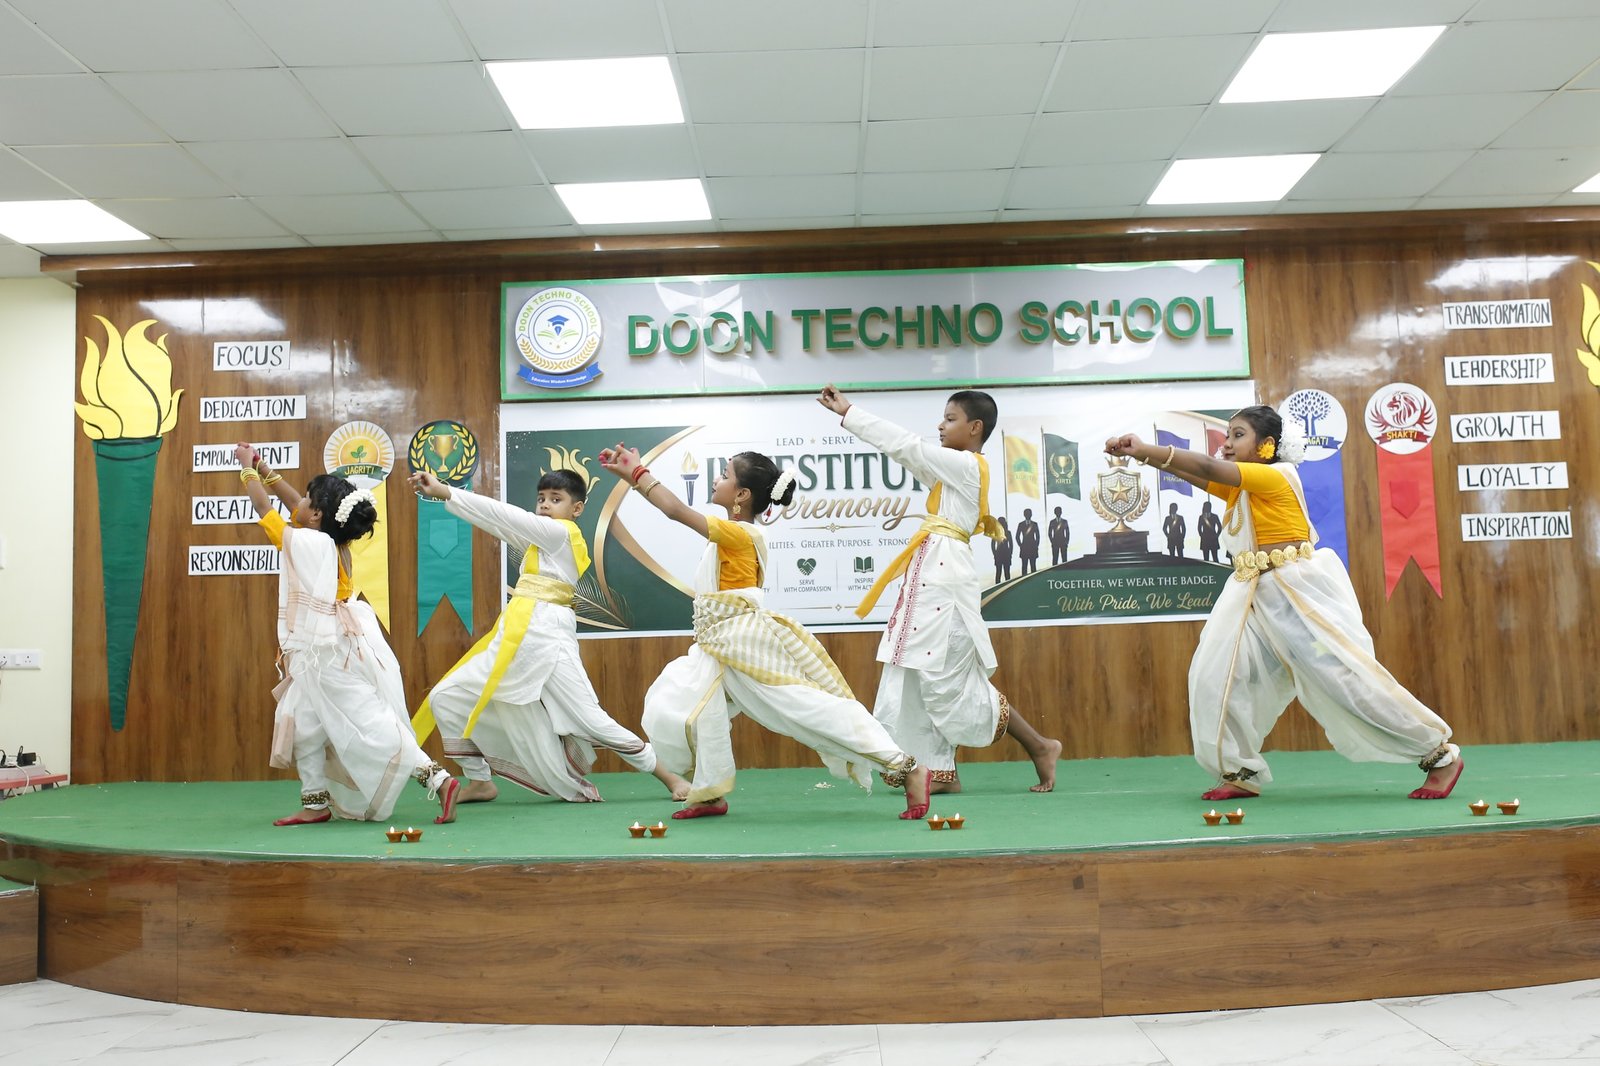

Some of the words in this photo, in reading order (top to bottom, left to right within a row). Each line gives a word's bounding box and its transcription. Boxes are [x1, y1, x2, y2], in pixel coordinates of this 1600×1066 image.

[519, 305, 534, 332] DOON
[533, 290, 572, 305] TECHNO
[575, 295, 598, 330] SCHOOL
[1444, 301, 1551, 325] TRANSFORMATION
[627, 309, 775, 357] DOON
[791, 301, 1003, 352] TECHNO
[1019, 295, 1234, 345] SCHOOL
[217, 344, 284, 367] FOCUS
[1451, 357, 1546, 379] LEADERSHIP
[203, 397, 296, 419] DEDICATION
[1386, 429, 1418, 441] SHAKTI
[1456, 414, 1545, 439] GROWTH
[776, 437, 804, 447] LEAD
[822, 436, 855, 445] SERVE
[1307, 436, 1329, 446] AGATI
[194, 445, 293, 467] EMPOWEENT
[344, 465, 375, 476] JAGRITI
[1466, 465, 1556, 488] LOYALTY
[1466, 514, 1570, 538] INSPIRATION
[769, 541, 796, 550] ILITIES.
[878, 537, 911, 547] STRONG
[191, 549, 280, 572] RESPONSIBILI
[1108, 578, 1124, 588] WE
[1126, 577, 1155, 588] WEAR
[1157, 577, 1177, 587] THE
[1180, 575, 1217, 586] BADGE.
[1057, 594, 1094, 613] With
[1099, 593, 1141, 612] Pride,
[1146, 593, 1173, 609] We
[1176, 591, 1214, 609] Lead.
